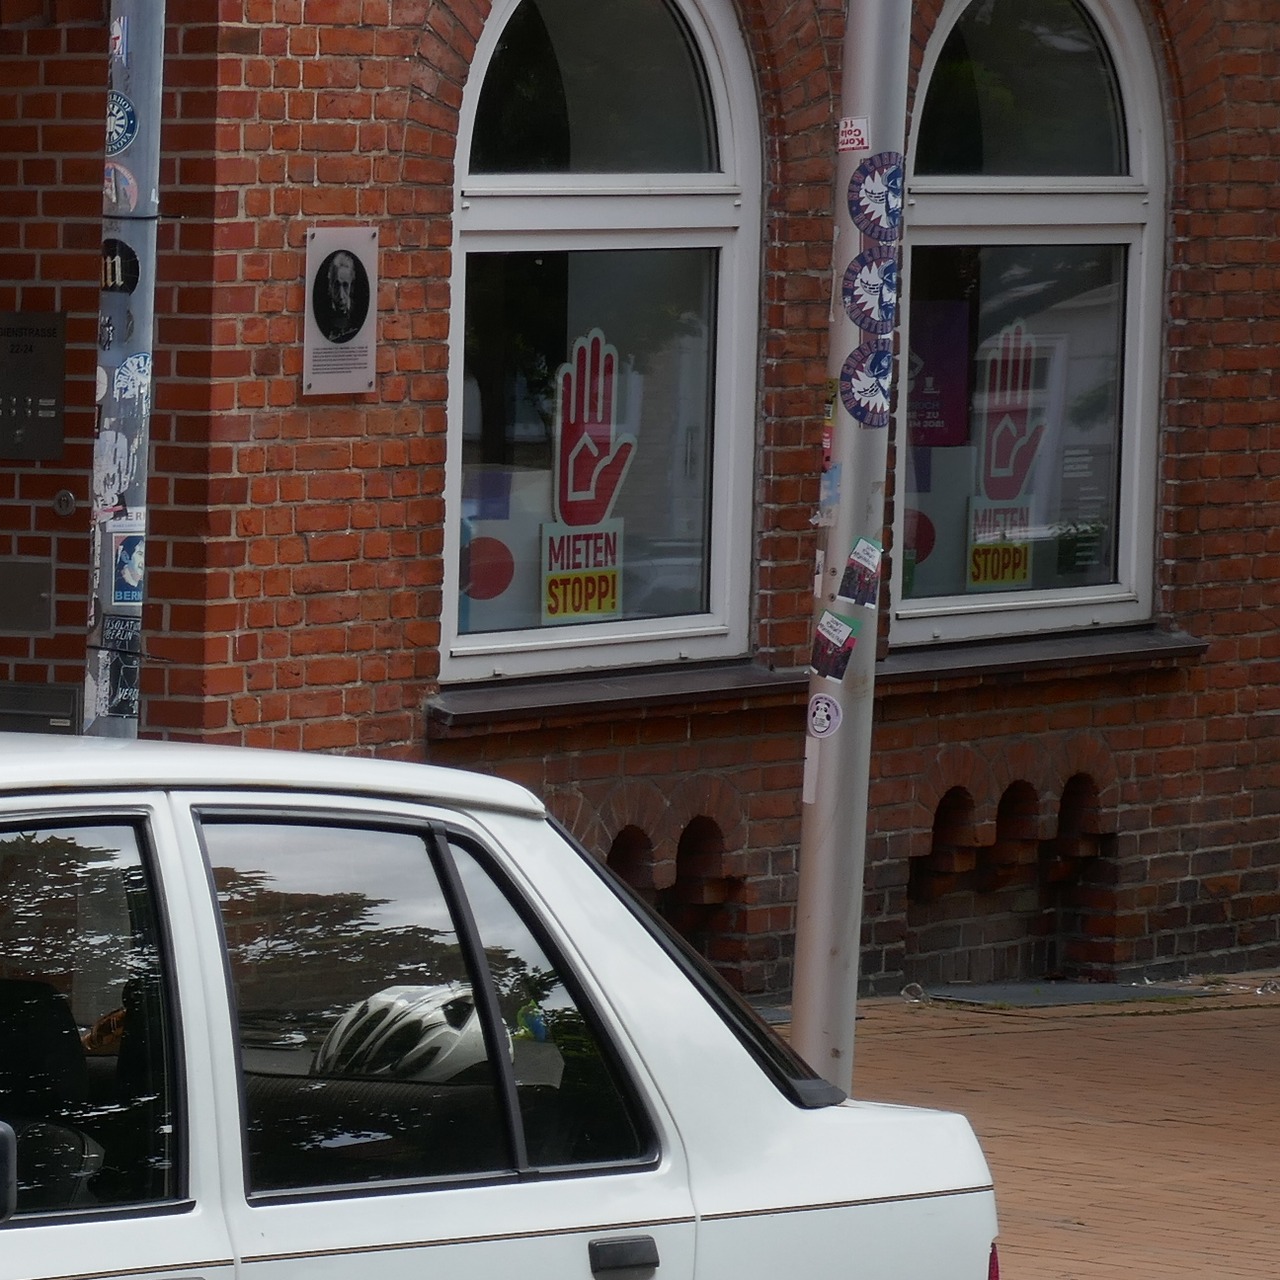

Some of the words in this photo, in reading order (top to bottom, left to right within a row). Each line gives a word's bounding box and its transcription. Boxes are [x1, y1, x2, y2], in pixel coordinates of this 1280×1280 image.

[973, 507, 1030, 541] MIETEN
[548, 531, 617, 571] MIETEN
[971, 546, 1029, 583] STOPP!
[547, 573, 617, 615] STOPP!
[105, 629, 133, 640] BERLIN
